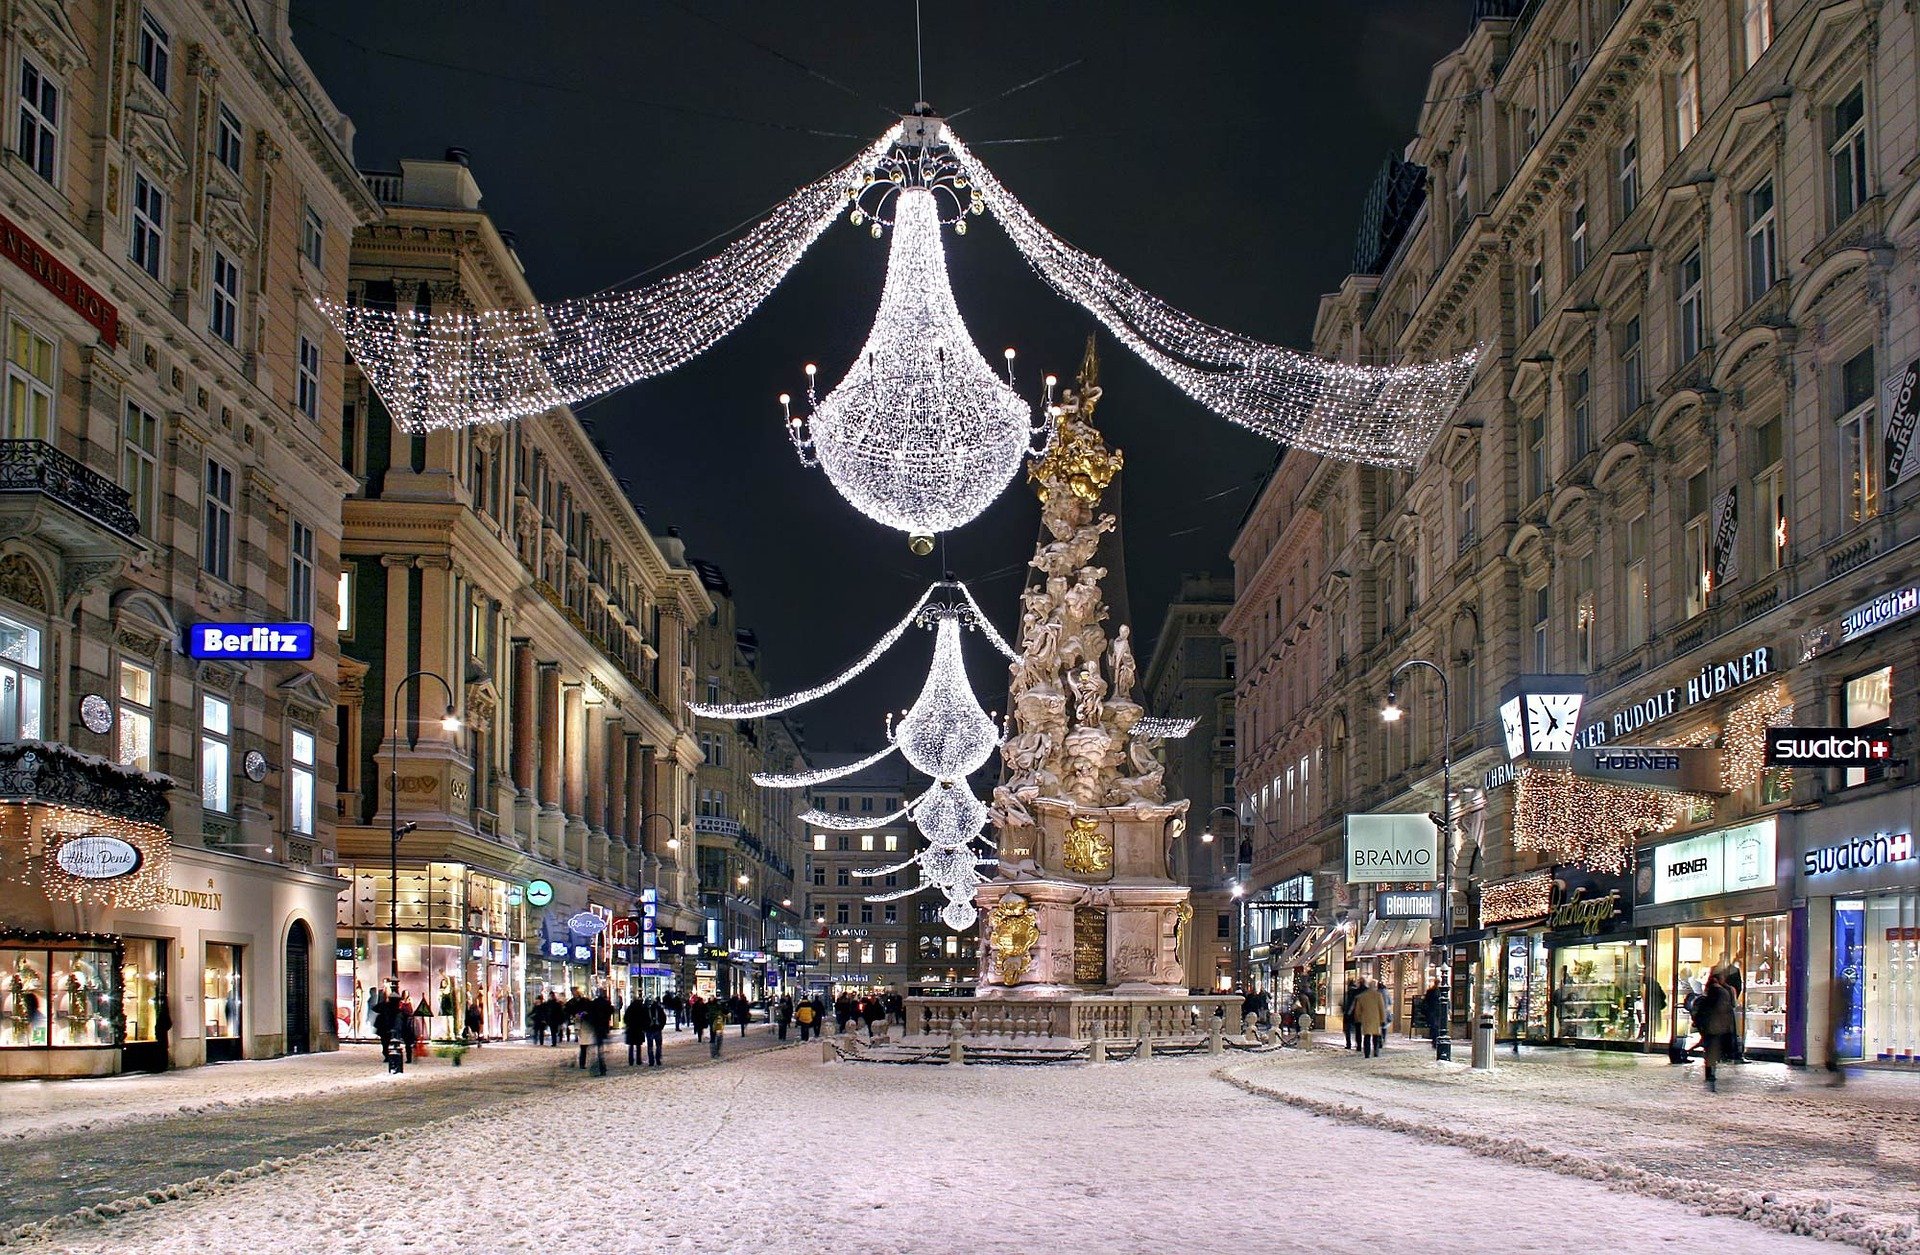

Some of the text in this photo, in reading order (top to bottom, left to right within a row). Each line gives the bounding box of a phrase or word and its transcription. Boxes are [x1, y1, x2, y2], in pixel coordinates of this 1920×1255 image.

[1888, 371, 1917, 443] ZIKOS
[1889, 413, 1915, 475] FURS
[1717, 518, 1738, 577] PELZE
[203, 627, 298, 652] Berlitz
[1614, 688, 1676, 738] RUDOLF
[1687, 646, 1768, 705] HÜBNER
[1776, 736, 1870, 759] swatch
[1354, 849, 1431, 866] BRAMO
[1804, 832, 1888, 876] swatch
